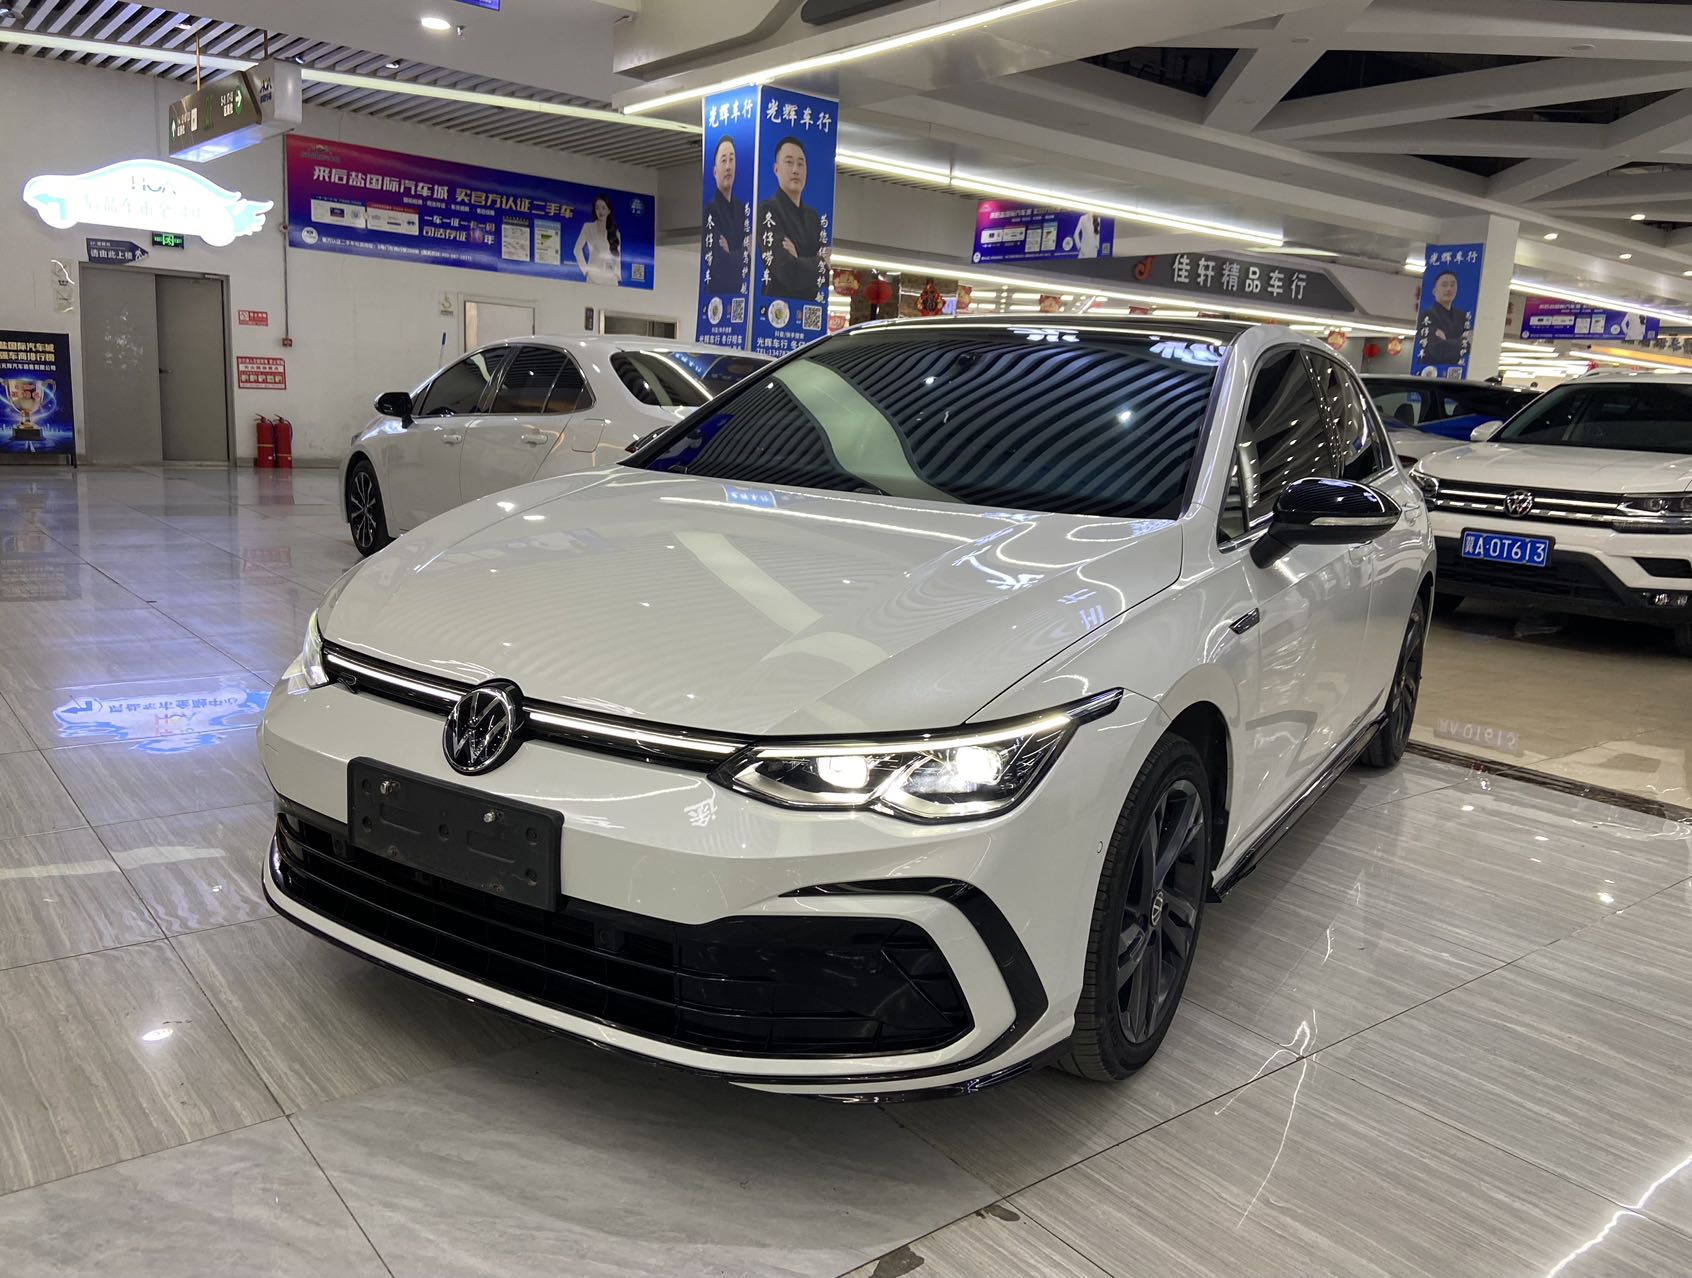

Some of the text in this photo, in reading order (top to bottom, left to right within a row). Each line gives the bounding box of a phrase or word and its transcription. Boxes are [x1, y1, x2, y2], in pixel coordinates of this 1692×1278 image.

[708, 98, 753, 128] 光辉车行
[766, 98, 832, 133] 光辉车行
[313, 165, 574, 219] 来后盐国际汽车城 买官方认证二手车
[1429, 250, 1478, 266] 光辉车行
[1172, 253, 1307, 300] 佳轩精品车行
[756, 337, 788, 349] 光辉车行
